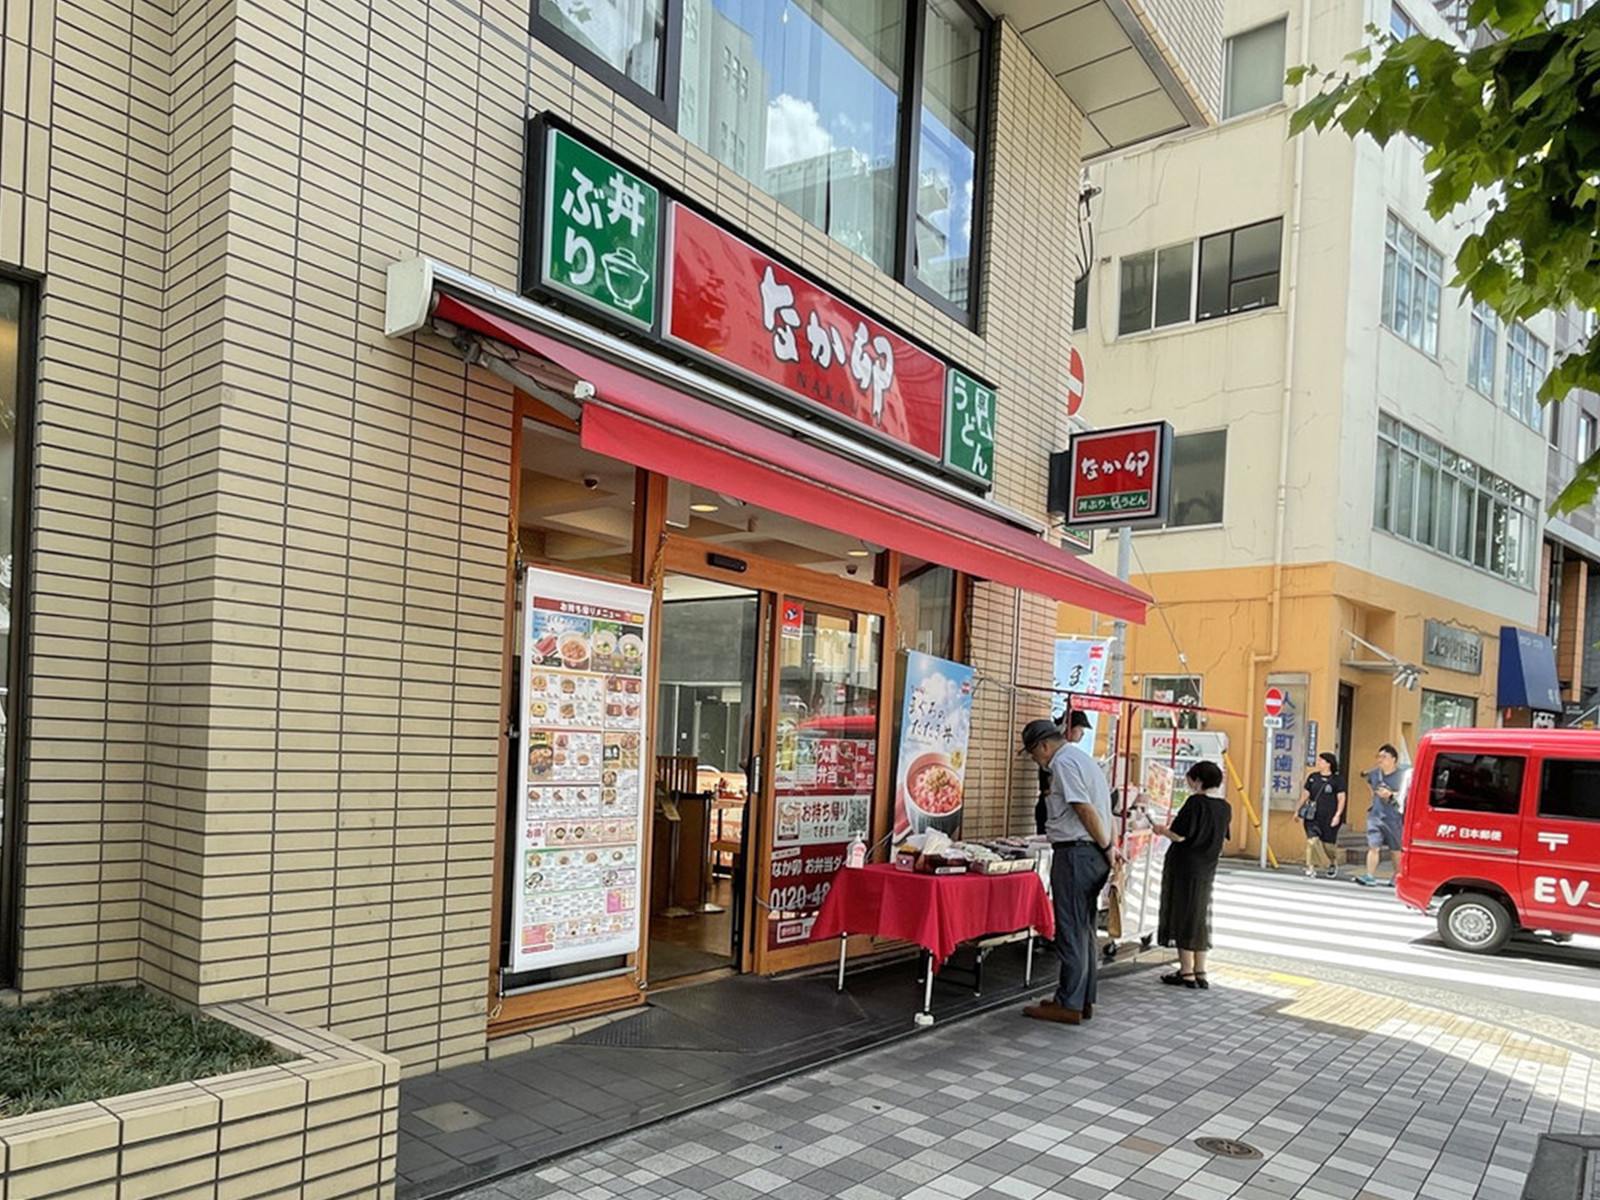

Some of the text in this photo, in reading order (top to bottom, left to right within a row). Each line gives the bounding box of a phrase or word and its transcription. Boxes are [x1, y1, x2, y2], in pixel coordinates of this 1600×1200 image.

[760, 265, 894, 427] なか卯
[1081, 450, 1150, 480] なか卯
[1273, 690, 1297, 794] 人形町歯科
[801, 801, 848, 823] お持ち帰り
[1459, 828, 1503, 841] 日本郵便
[1534, 876, 1590, 907] EV
